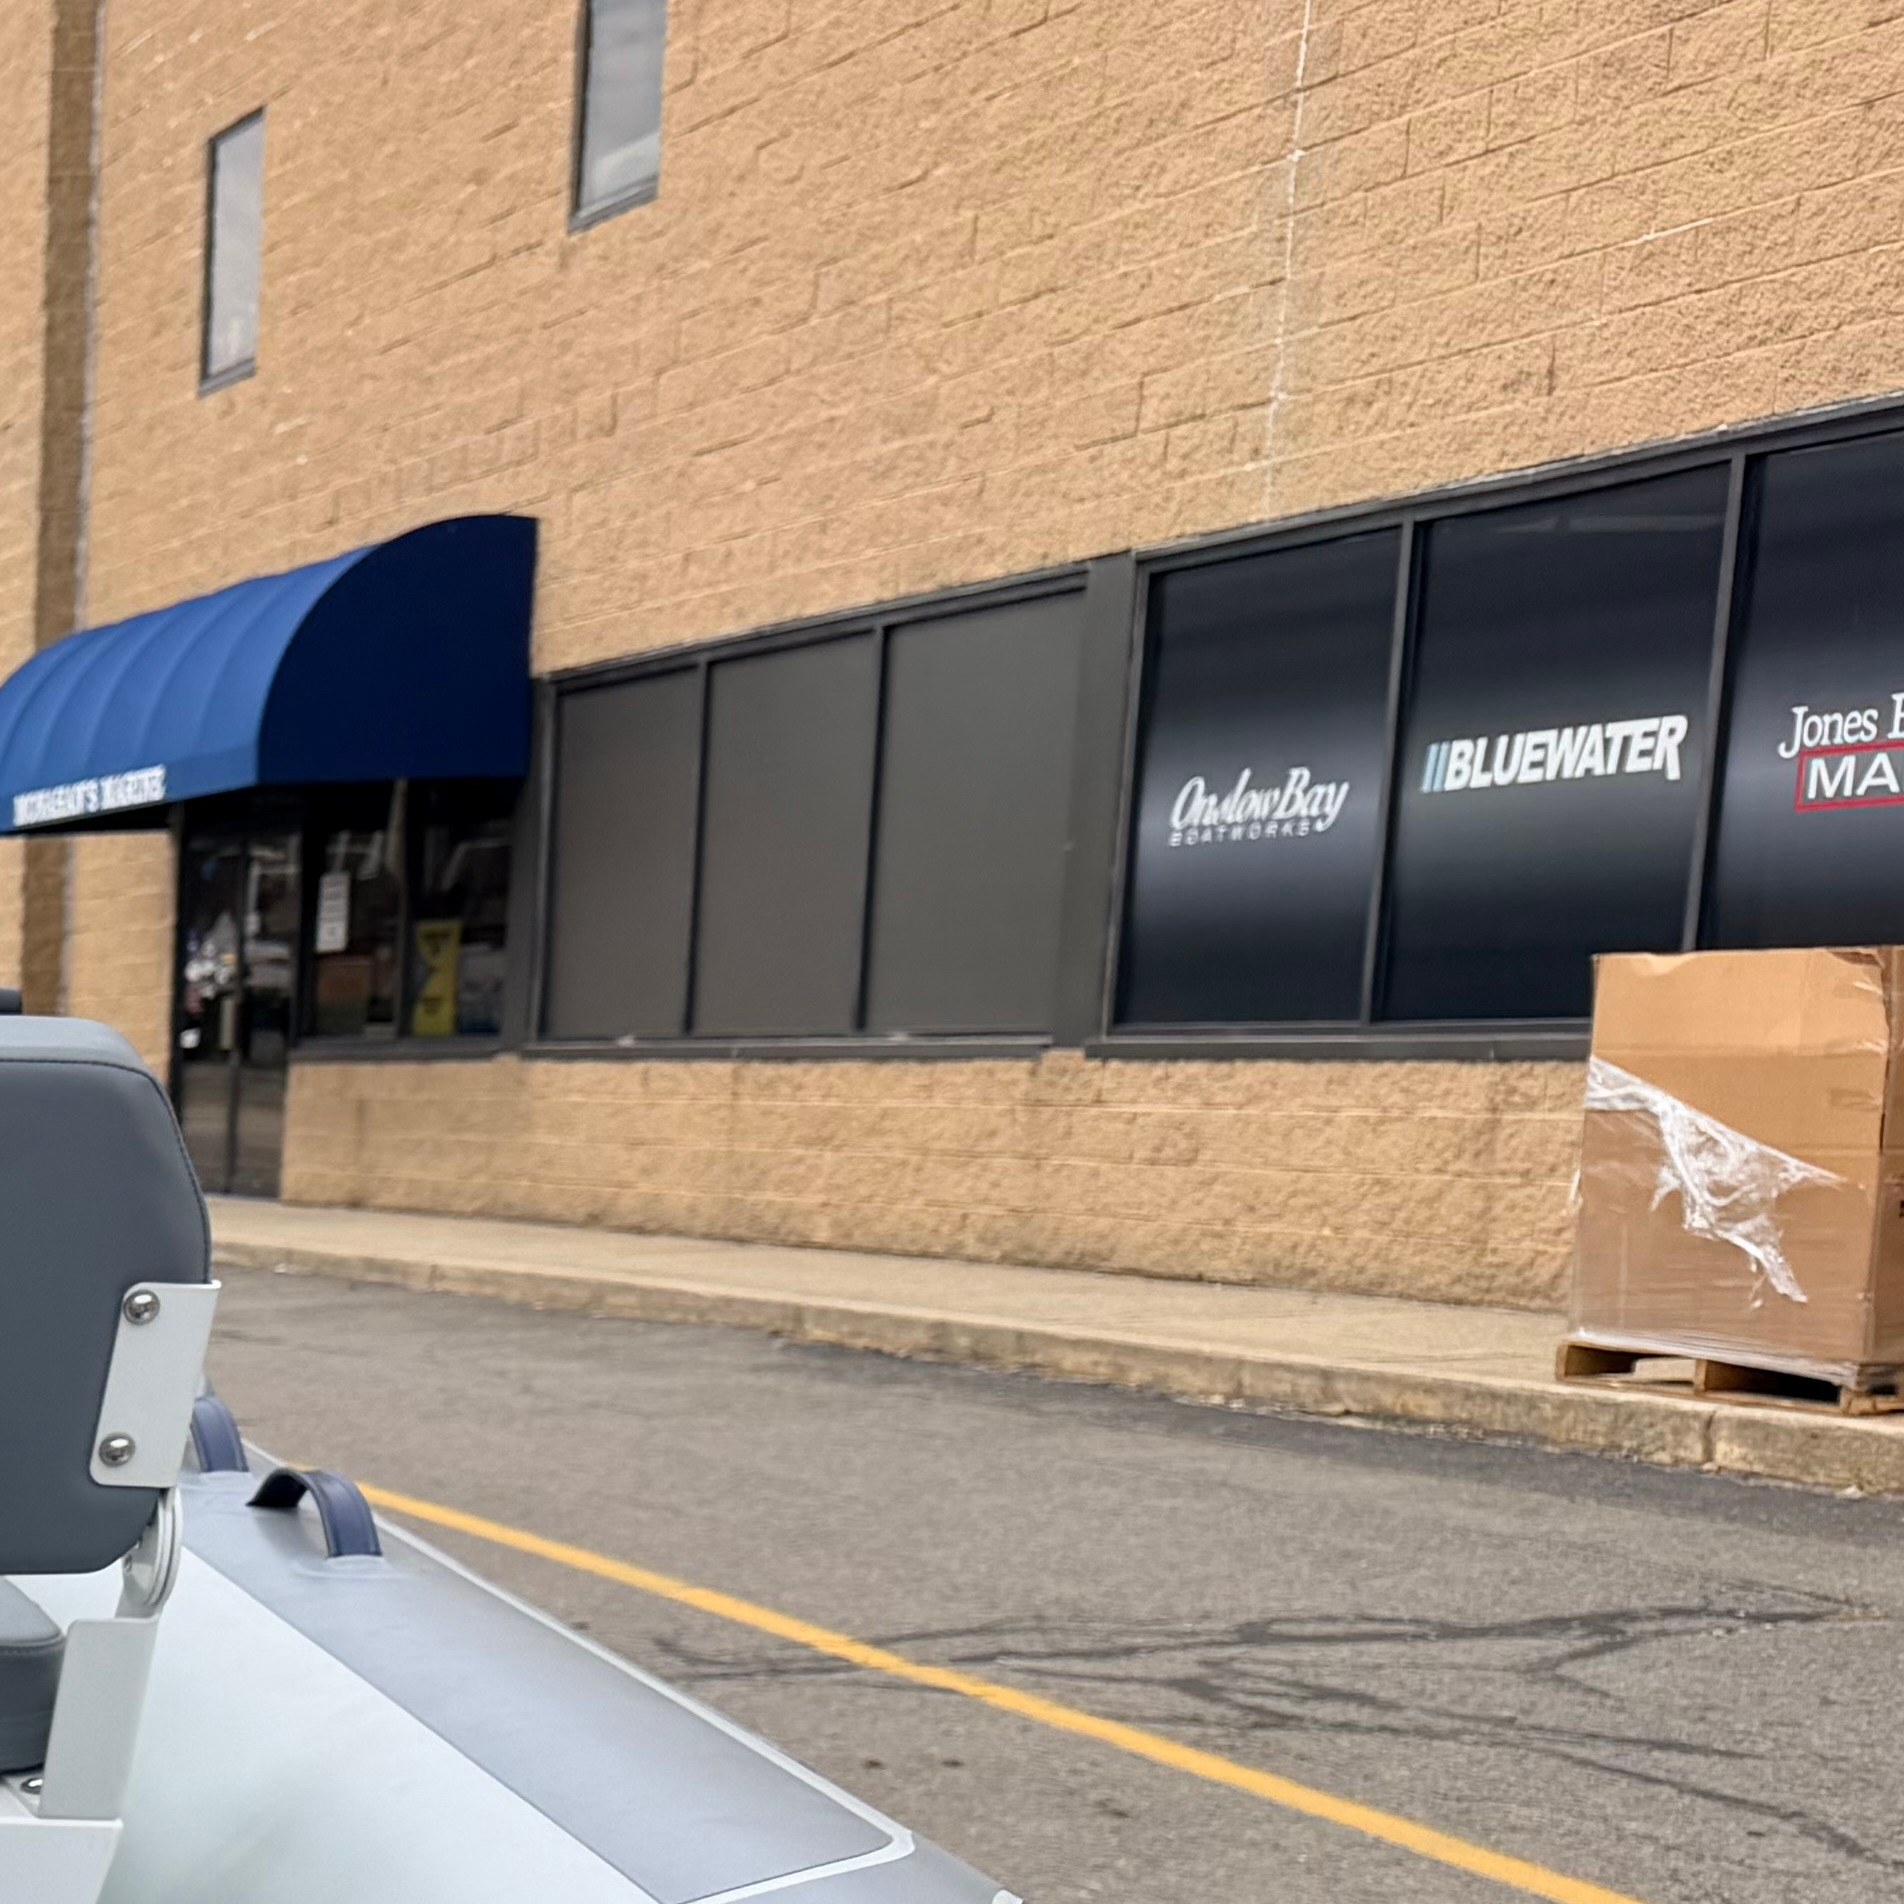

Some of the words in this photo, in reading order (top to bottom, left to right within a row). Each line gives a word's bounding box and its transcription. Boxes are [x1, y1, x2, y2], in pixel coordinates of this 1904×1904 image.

[1444, 714, 1688, 791] BLUEWATER
[1778, 705, 1879, 759] Jones
[1272, 766, 1350, 832] Bay
[1807, 752, 1904, 799] MA
[1169, 816, 1310, 847] BOATWORKS
